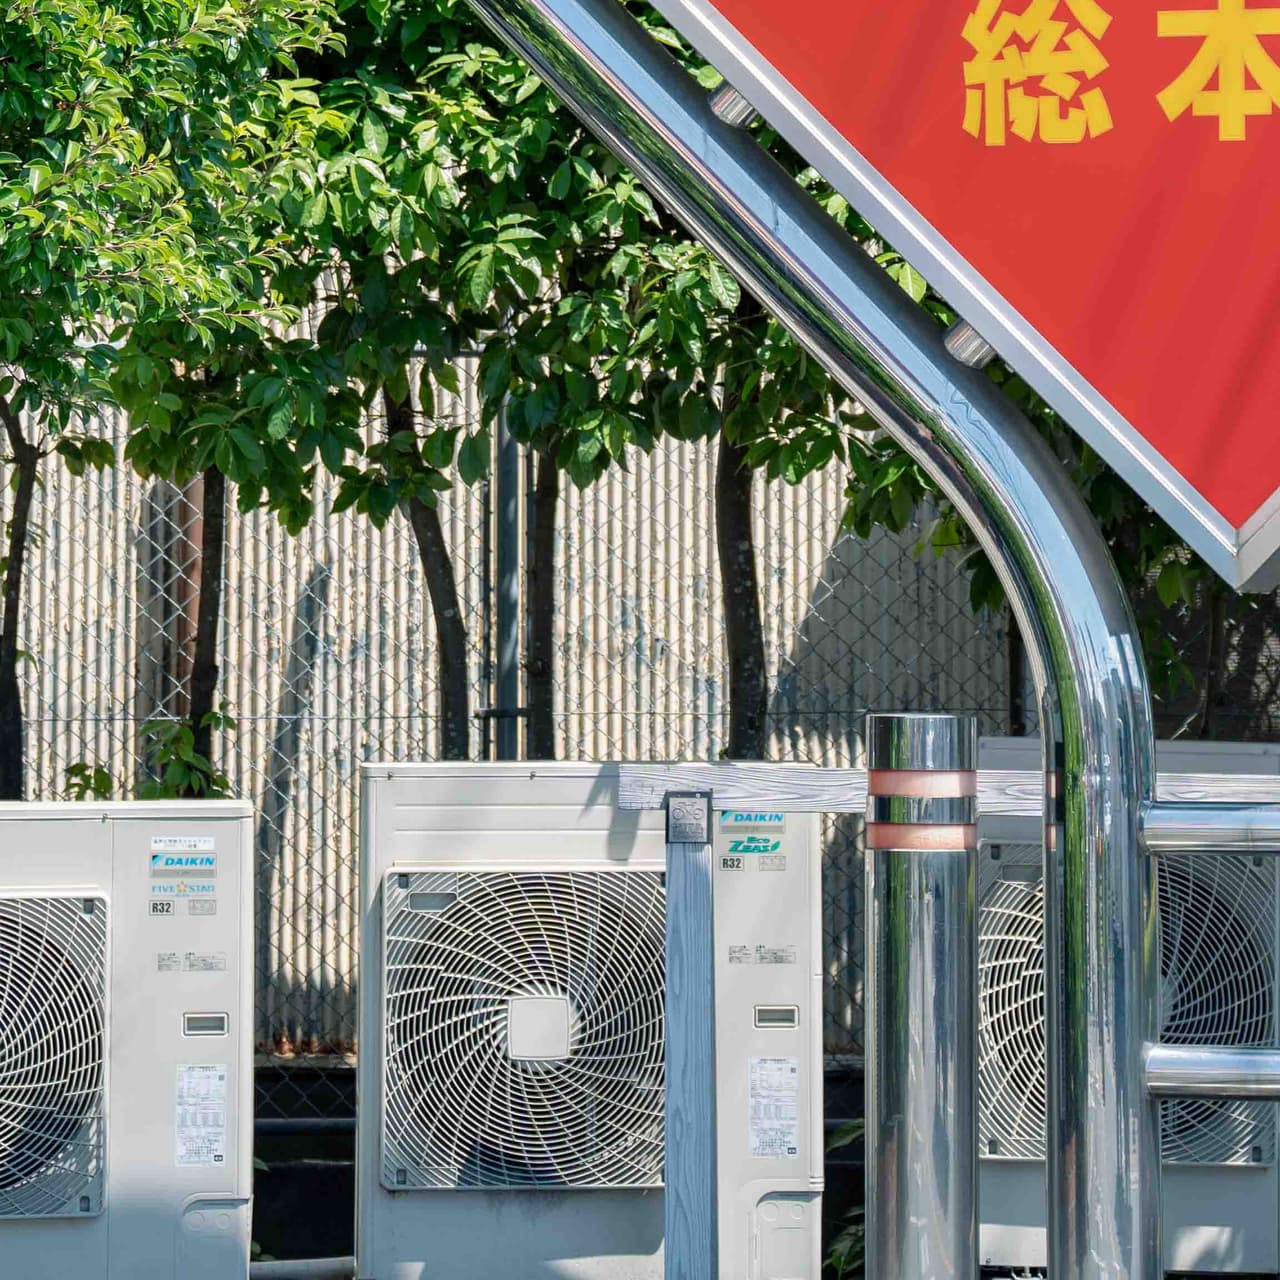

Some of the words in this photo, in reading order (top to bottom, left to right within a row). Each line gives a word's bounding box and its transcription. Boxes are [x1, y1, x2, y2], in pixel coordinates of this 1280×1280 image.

[734, 812, 783, 823] DAIKIN
[164, 856, 215, 867] DAIKIN
[722, 857, 742, 869] R32
[151, 901, 172, 914] R32
